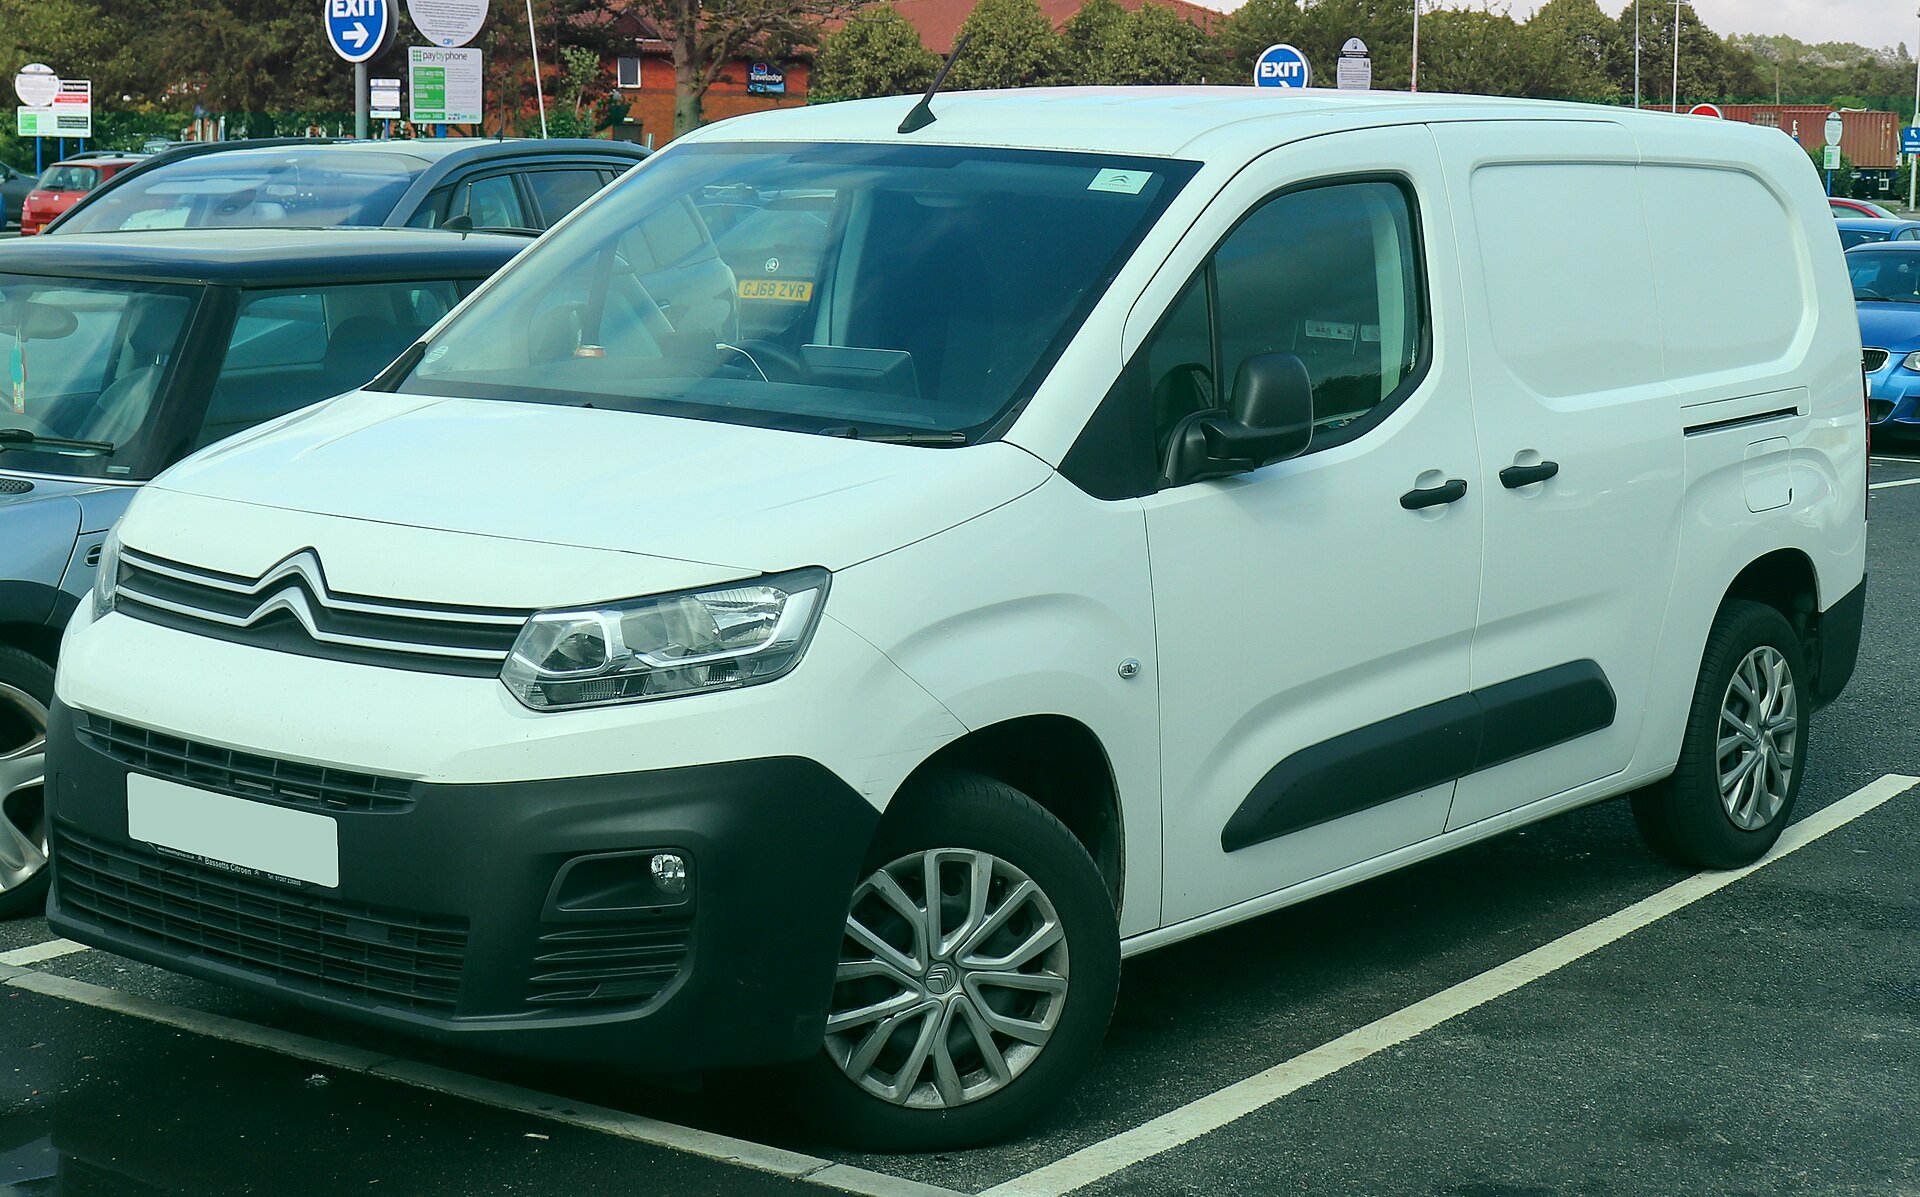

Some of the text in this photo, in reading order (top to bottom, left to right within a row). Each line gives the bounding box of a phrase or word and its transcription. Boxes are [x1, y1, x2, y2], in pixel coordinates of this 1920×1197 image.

[332, 0, 376, 18] EXIT
[422, 50, 468, 62] paybyphone
[1261, 61, 1302, 78] EXIT
[750, 72, 783, 83] Travelodge
[743, 282, 805, 298] GJ68 ZVR
[204, 856, 230, 870] Bassetts
